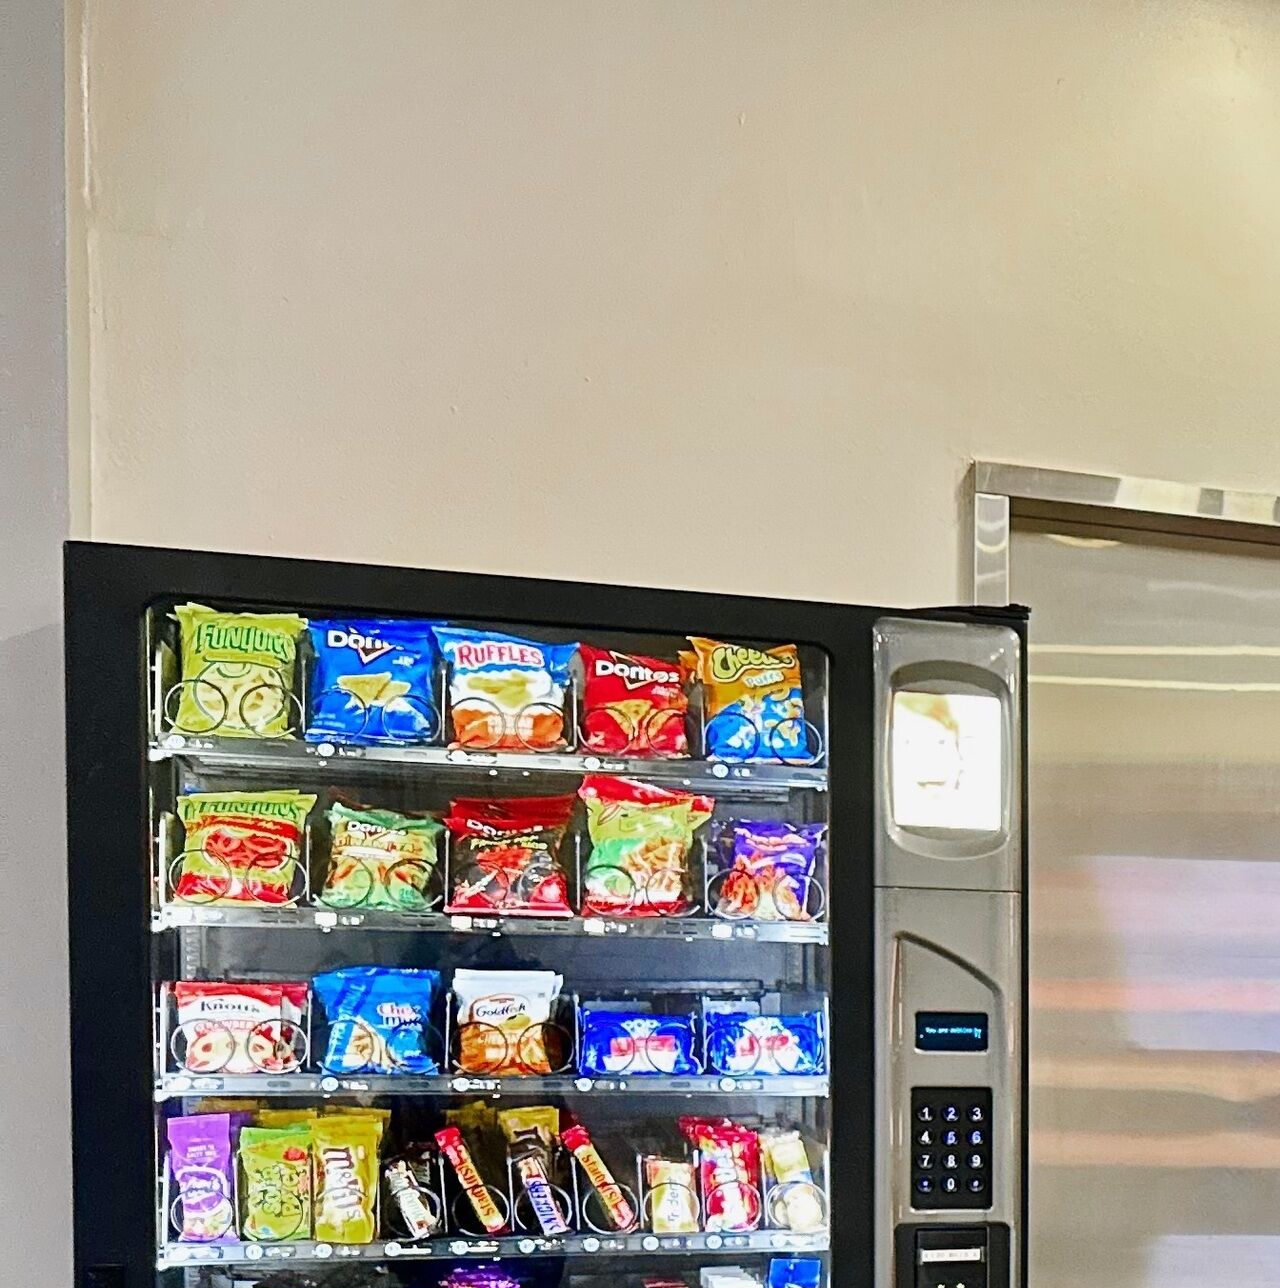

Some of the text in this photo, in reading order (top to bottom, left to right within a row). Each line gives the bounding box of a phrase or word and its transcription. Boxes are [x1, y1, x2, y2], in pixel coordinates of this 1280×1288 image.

[457, 642, 543, 668] RUFFLES
[595, 659, 680, 684] Doritos
[922, 1107, 930, 1119] 1
[948, 1107, 956, 1119] 2
[973, 1107, 982, 1119] 3
[921, 1131, 930, 1143] 4
[948, 1131, 956, 1143] 5
[972, 1131, 981, 1143] 6
[922, 1155, 930, 1167] 7
[947, 1155, 956, 1166] 8
[972, 1155, 981, 1166] 9
[579, 1152, 623, 1209] Starburst
[947, 1178, 955, 1190] 0
[458, 1163, 495, 1217] Starburst
